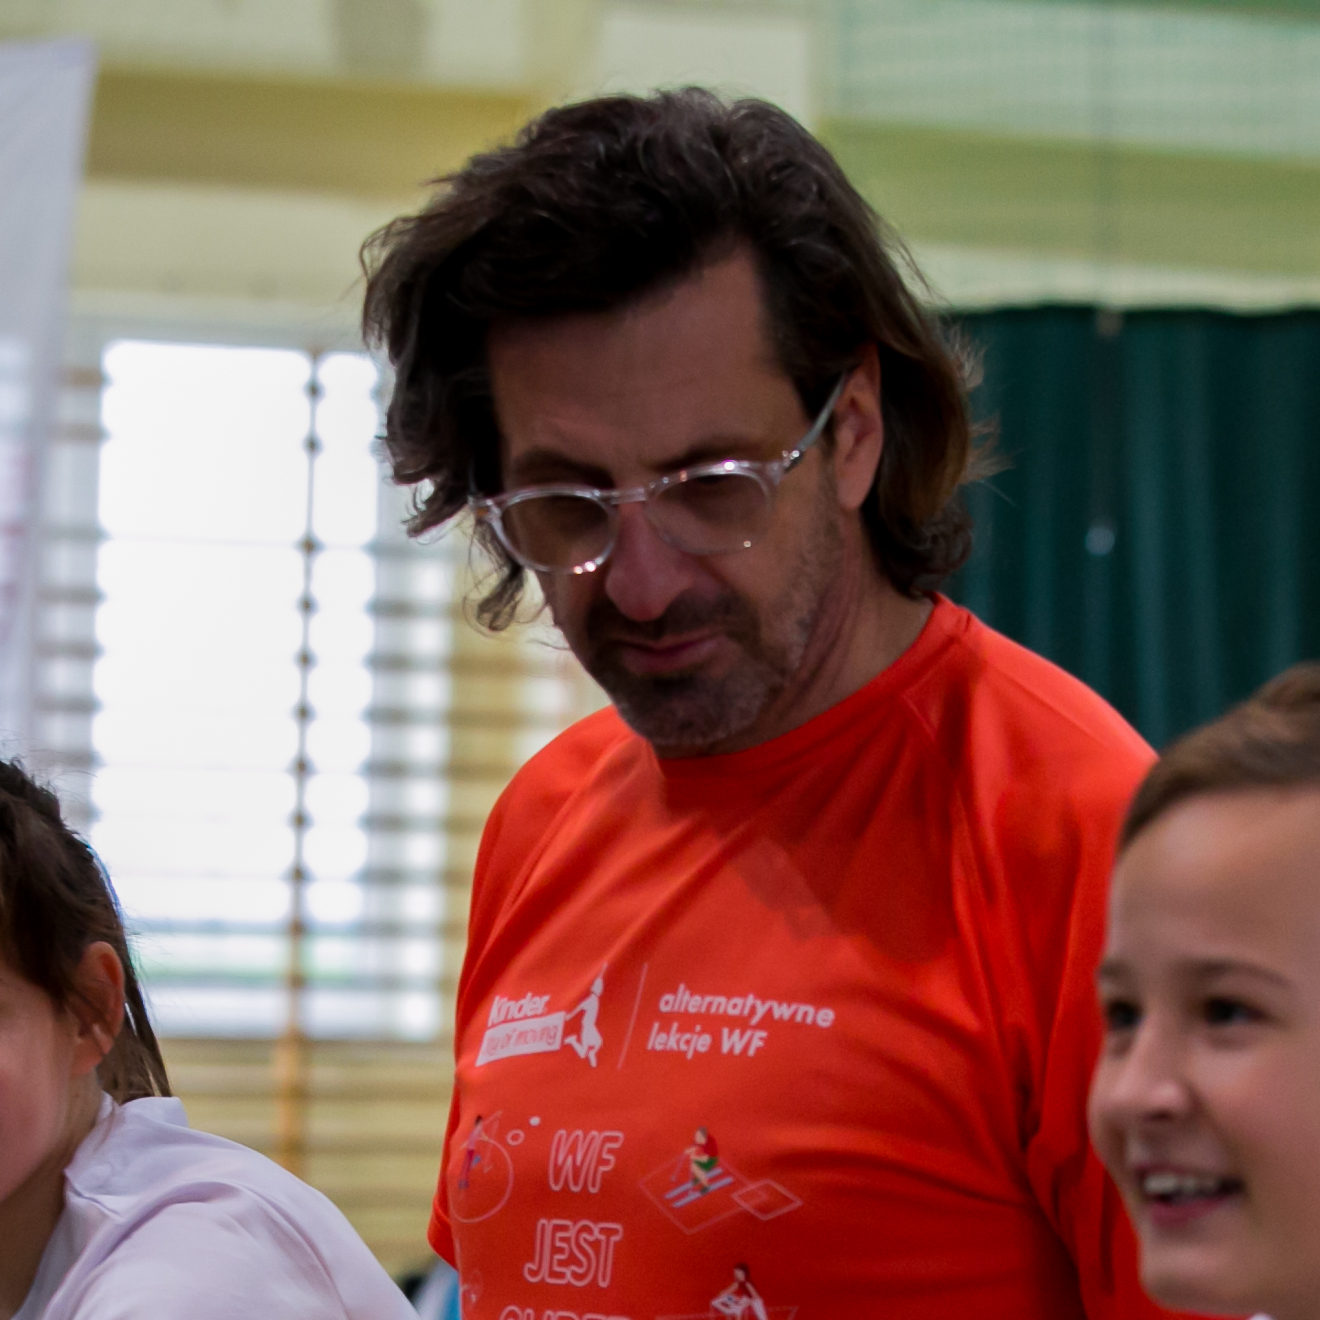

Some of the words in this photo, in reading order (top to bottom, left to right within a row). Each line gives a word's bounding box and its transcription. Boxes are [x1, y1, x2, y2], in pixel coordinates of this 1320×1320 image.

[659, 983, 835, 1028] alternatywne
[647, 1022, 712, 1060] lekcje
[721, 1027, 767, 1058] WF
[548, 1129, 624, 1194] WF
[523, 1218, 623, 1288] JEST
